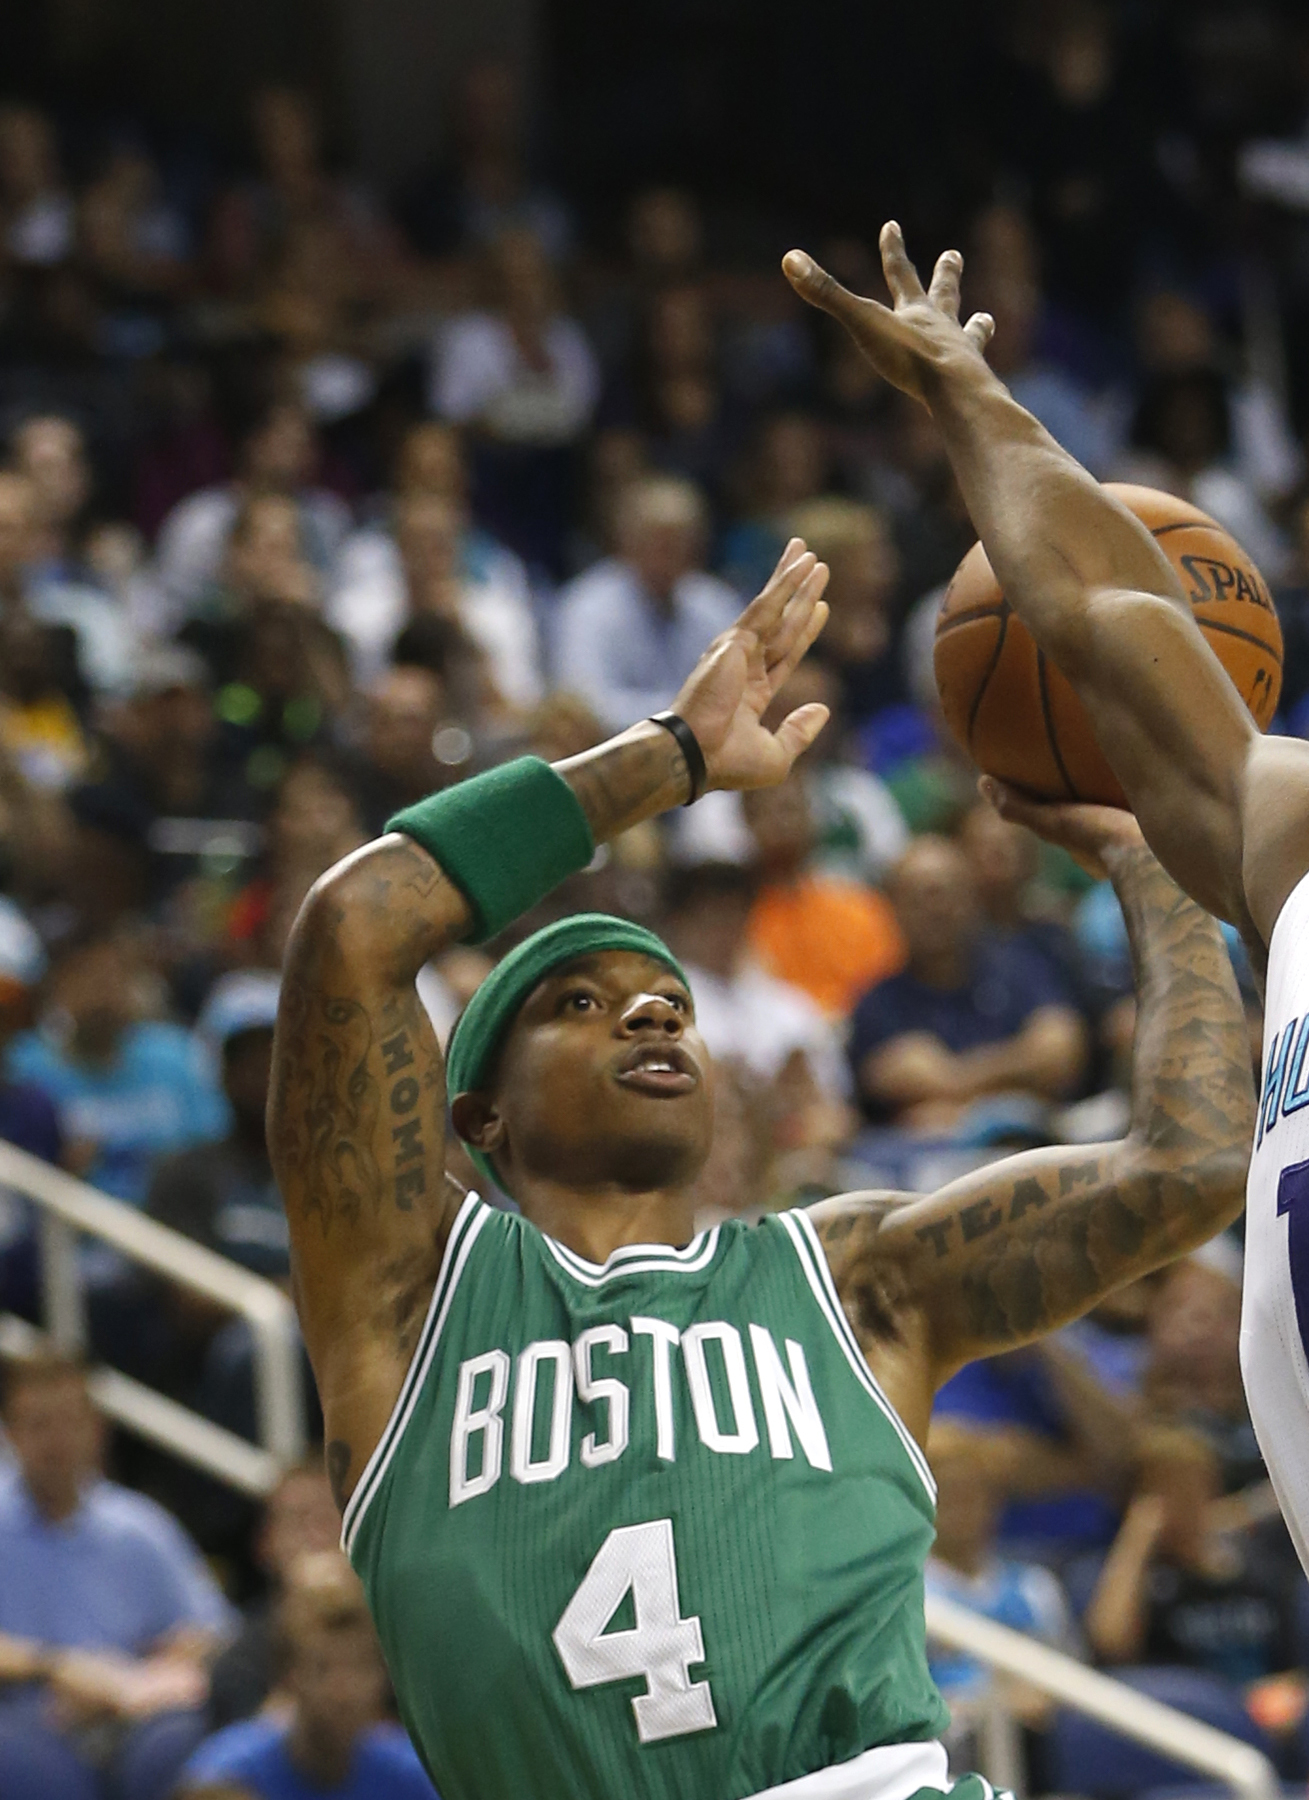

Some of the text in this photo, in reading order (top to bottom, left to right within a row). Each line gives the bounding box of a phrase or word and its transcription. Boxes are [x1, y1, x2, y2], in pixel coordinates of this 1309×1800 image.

[379, 1030, 428, 1213] HOME
[449, 1315, 833, 1510] BOSTON
[552, 1518, 719, 1744] 4
